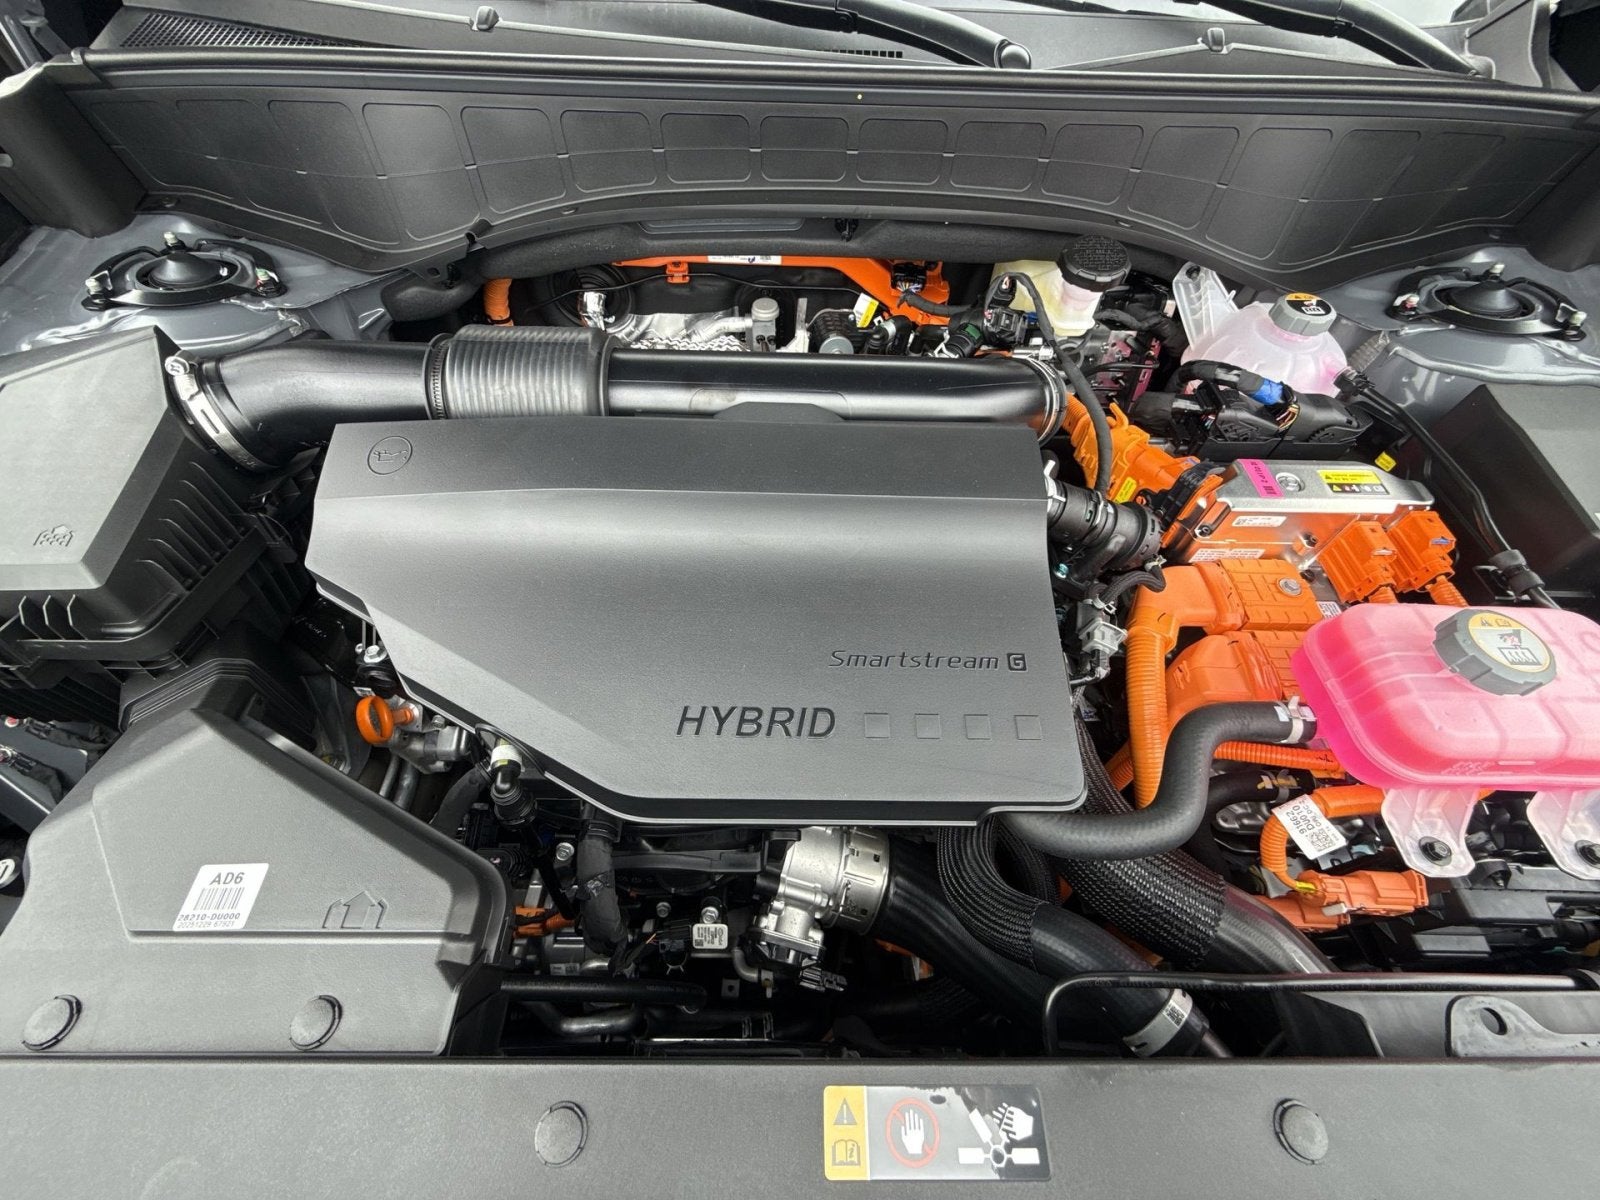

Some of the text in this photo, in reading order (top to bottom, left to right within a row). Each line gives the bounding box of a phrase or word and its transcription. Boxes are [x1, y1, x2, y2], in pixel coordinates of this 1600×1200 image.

[828, 650, 1027, 671] Smartstream G
[675, 705, 836, 739] HYBRID
[209, 871, 245, 885] AD6
